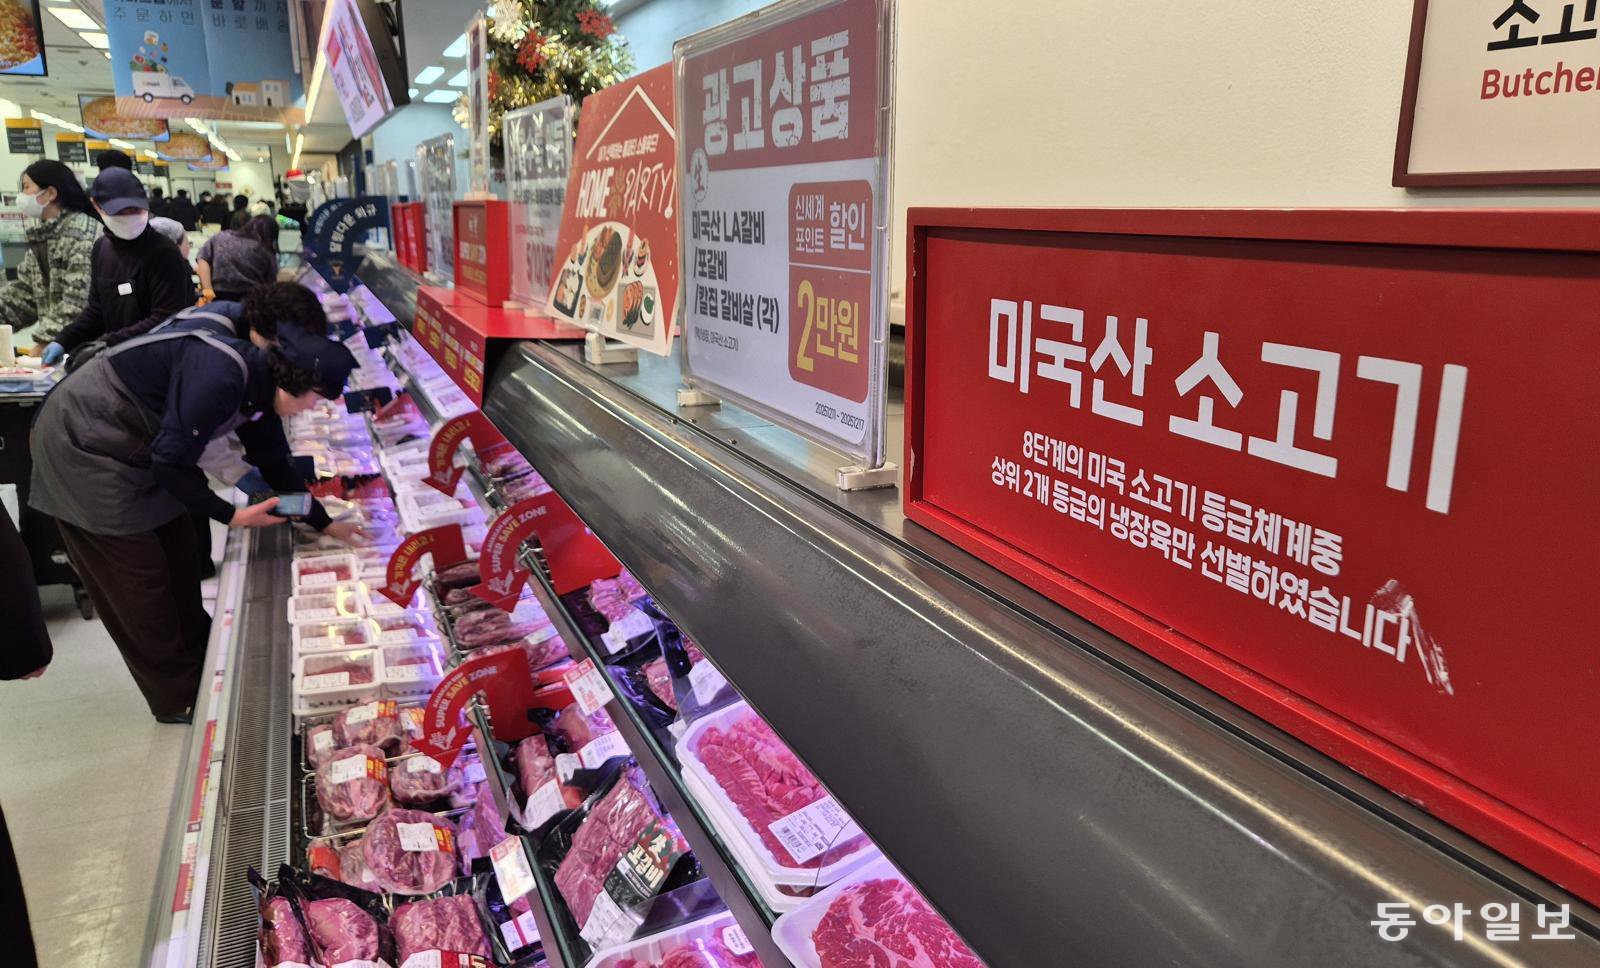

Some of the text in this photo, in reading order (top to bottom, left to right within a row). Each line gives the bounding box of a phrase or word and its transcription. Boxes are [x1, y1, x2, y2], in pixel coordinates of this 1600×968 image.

[701, 29, 852, 156] 광고상품
[1481, 62, 1600, 99] Butche
[576, 166, 615, 218] HOME
[795, 194, 825, 221] 신세계
[692, 210, 765, 245] 미국산 LA갈비
[795, 227, 825, 253] 포인트
[830, 201, 865, 250] 할인
[721, 288, 754, 327] 갈비살
[757, 295, 780, 334] (각)
[796, 279, 859, 372] 2만원
[988, 298, 1468, 515] 미국산 소고기
[1022, 430, 1344, 577] 8단계의 미국 소고기 등급체계중
[492, 542, 504, 574] SUPER
[498, 518, 521, 543] SAVE
[517, 505, 548, 524] ZONE
[991, 456, 1412, 664] 상위 2개 등급의 냉장육만 선별하였습니다
[435, 698, 452, 729] SUPER
[445, 676, 470, 700] SAVE
[467, 665, 498, 682] ZONE
